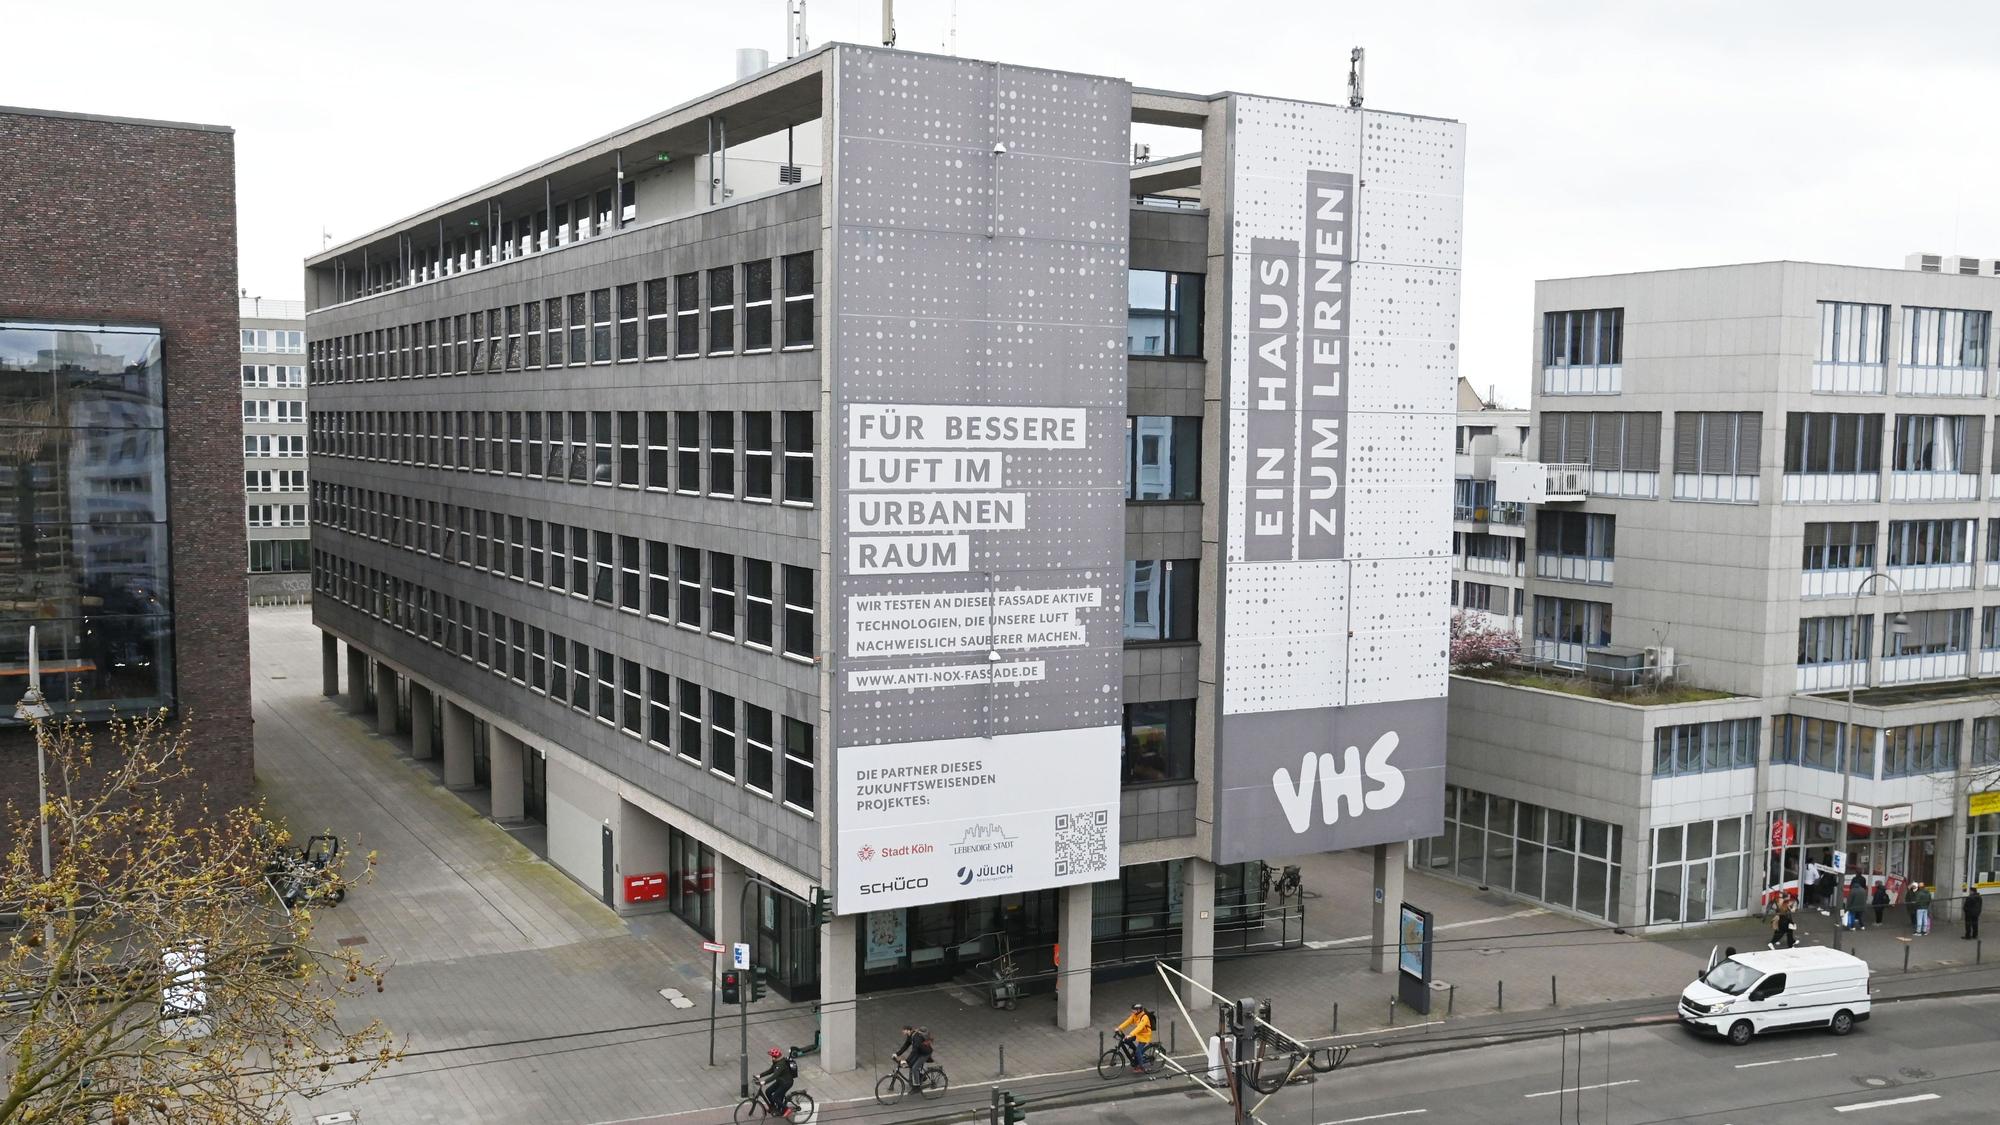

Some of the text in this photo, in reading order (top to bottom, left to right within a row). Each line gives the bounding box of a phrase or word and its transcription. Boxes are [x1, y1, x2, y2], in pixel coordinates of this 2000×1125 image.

[1307, 187, 1347, 537] ZUM LERNEN
[1254, 257, 1291, 537] EIN HAUS
[859, 408, 1076, 441] FÜR BESSERE
[859, 458, 991, 483] LUFT IM
[859, 500, 1014, 526] URBANEN
[859, 542, 957, 569] RAUM
[856, 592, 1094, 612] WIR TESTEN AN DIESER FASSADE AKTIVE
[856, 612, 1069, 632] TECHNOLOGIEN, DIE UNSERE LUFT
[856, 630, 1082, 652] NACHWEISLICH SAUBERER MACHEN.
[856, 666, 1039, 687] WWW.ANTI-NOX-FASSADE.DE
[857, 760, 983, 781] DIE PARTNER DIESES
[856, 774, 996, 796] ZUKUNFTSWEISENDEN
[1272, 730, 1407, 834] VHS
[856, 796, 930, 811] PROJEKTES:
[881, 842, 934, 858] Stadt Köln
[954, 841, 1015, 855] LEBENDIGE STADT
[976, 863, 1014, 877] JÜLICH
[860, 876, 929, 895] SCHÜCO
